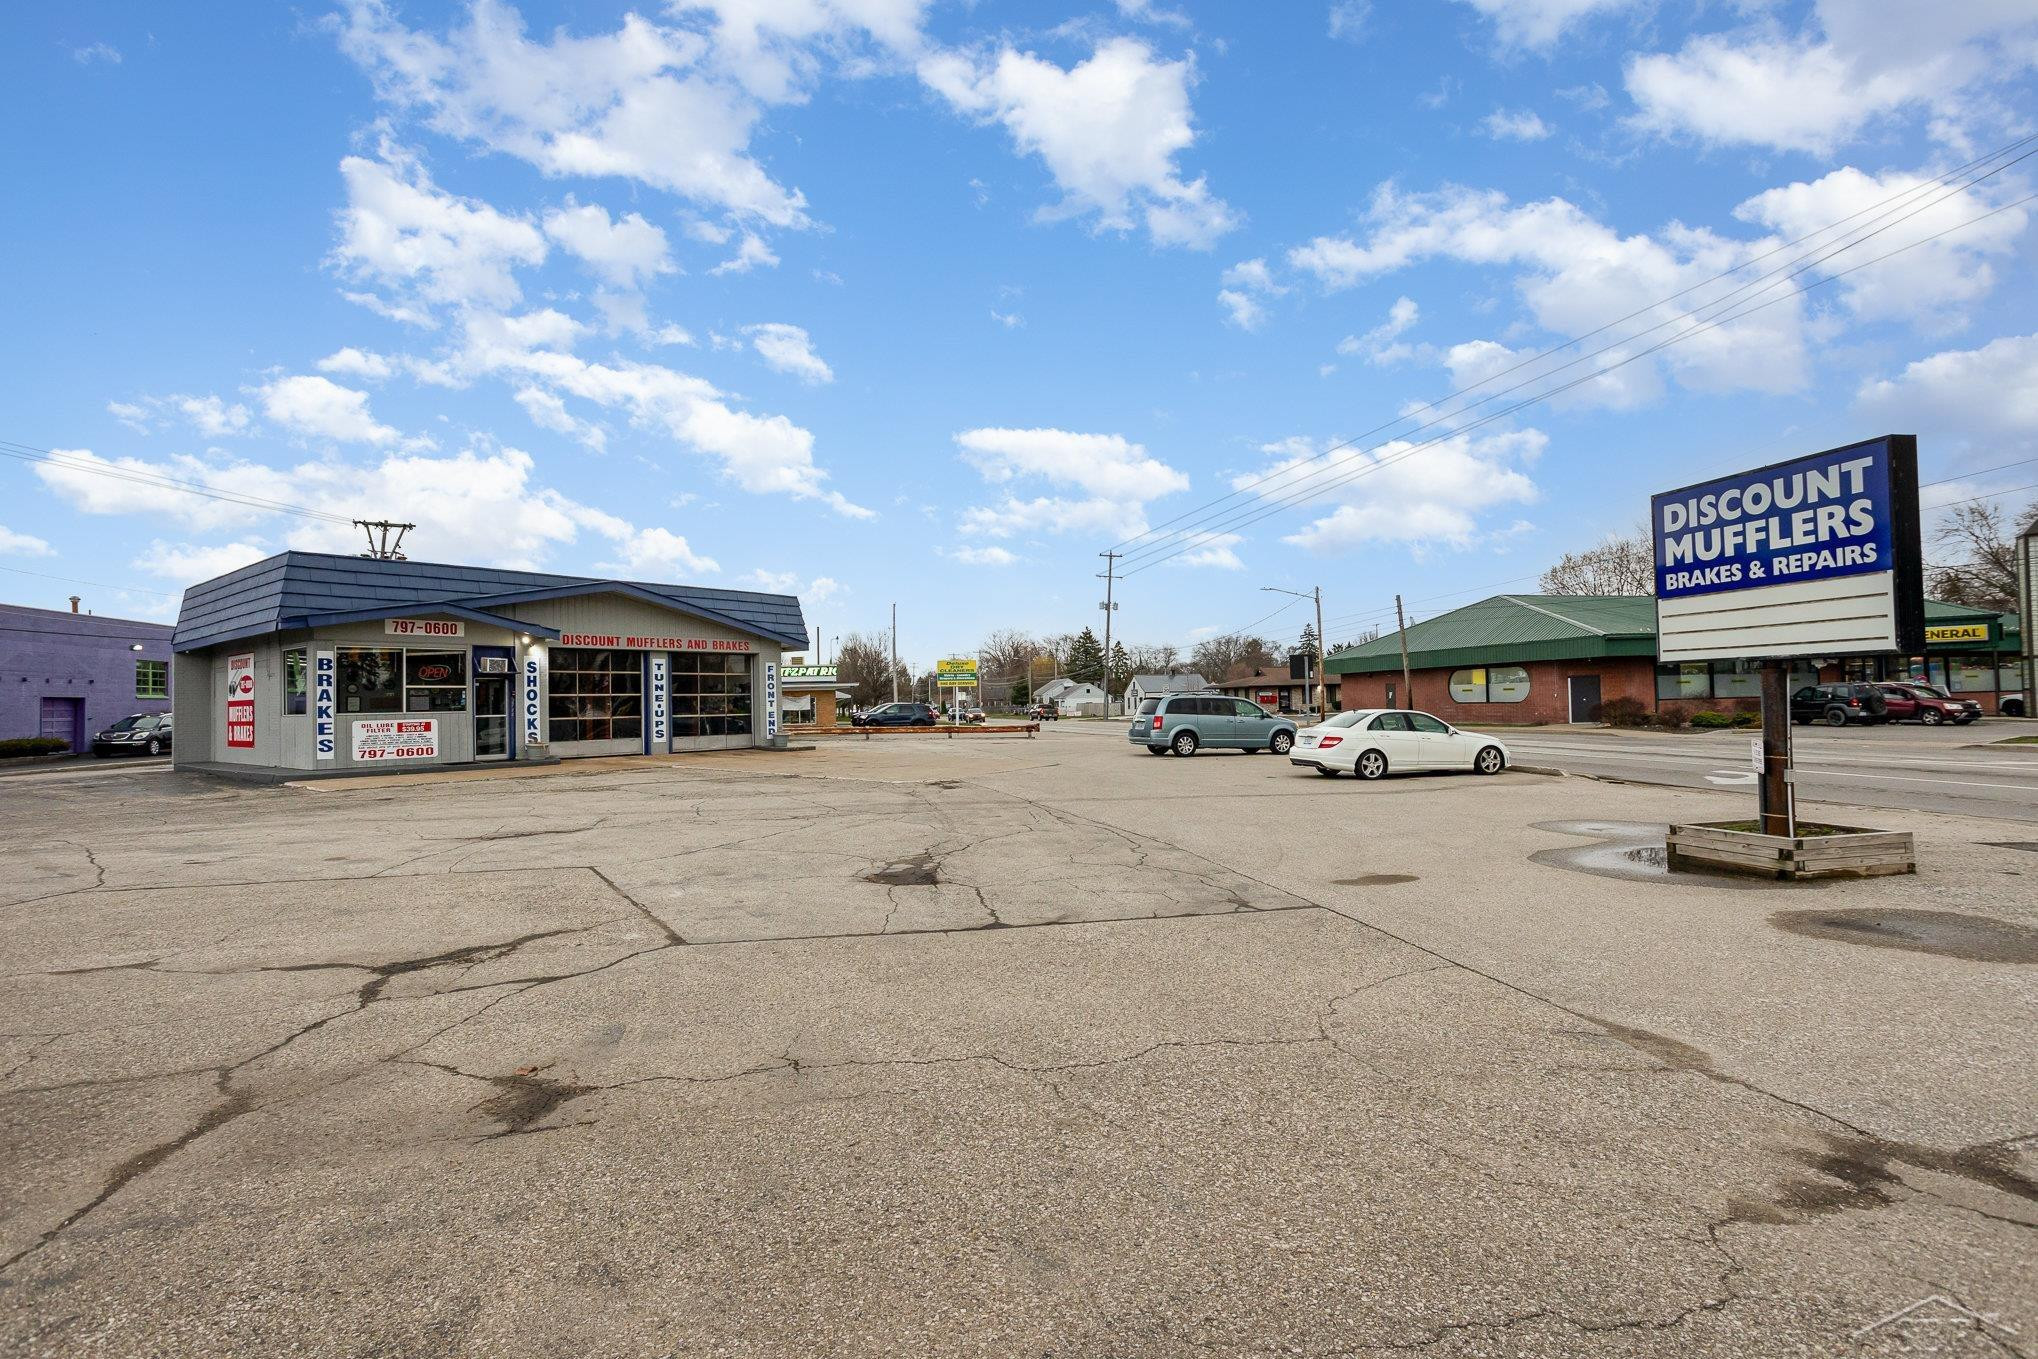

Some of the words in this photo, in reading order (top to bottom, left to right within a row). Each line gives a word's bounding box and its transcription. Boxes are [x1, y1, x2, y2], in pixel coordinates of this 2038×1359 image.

[1663, 456, 1873, 533] DISCOUNT
[1664, 499, 1875, 567] MUFFLERS
[1665, 563, 1742, 591] BRAKES
[1748, 560, 1766, 580] &
[1773, 542, 1878, 576] REPAIRS
[391, 620, 458, 635] 797-0600
[562, 634, 621, 647] DISCOUNT
[626, 637, 683, 649] MUFFLERS
[687, 639, 708, 650] AND
[712, 640, 750, 651] BRAKES
[419, 665, 449, 678] OPEN
[767, 665, 775, 708] FRONT
[317, 657, 334, 753] BRAKES
[526, 661, 539, 744] SHOCKS
[768, 711, 776, 736] END
[358, 747, 434, 759] 797-0600
